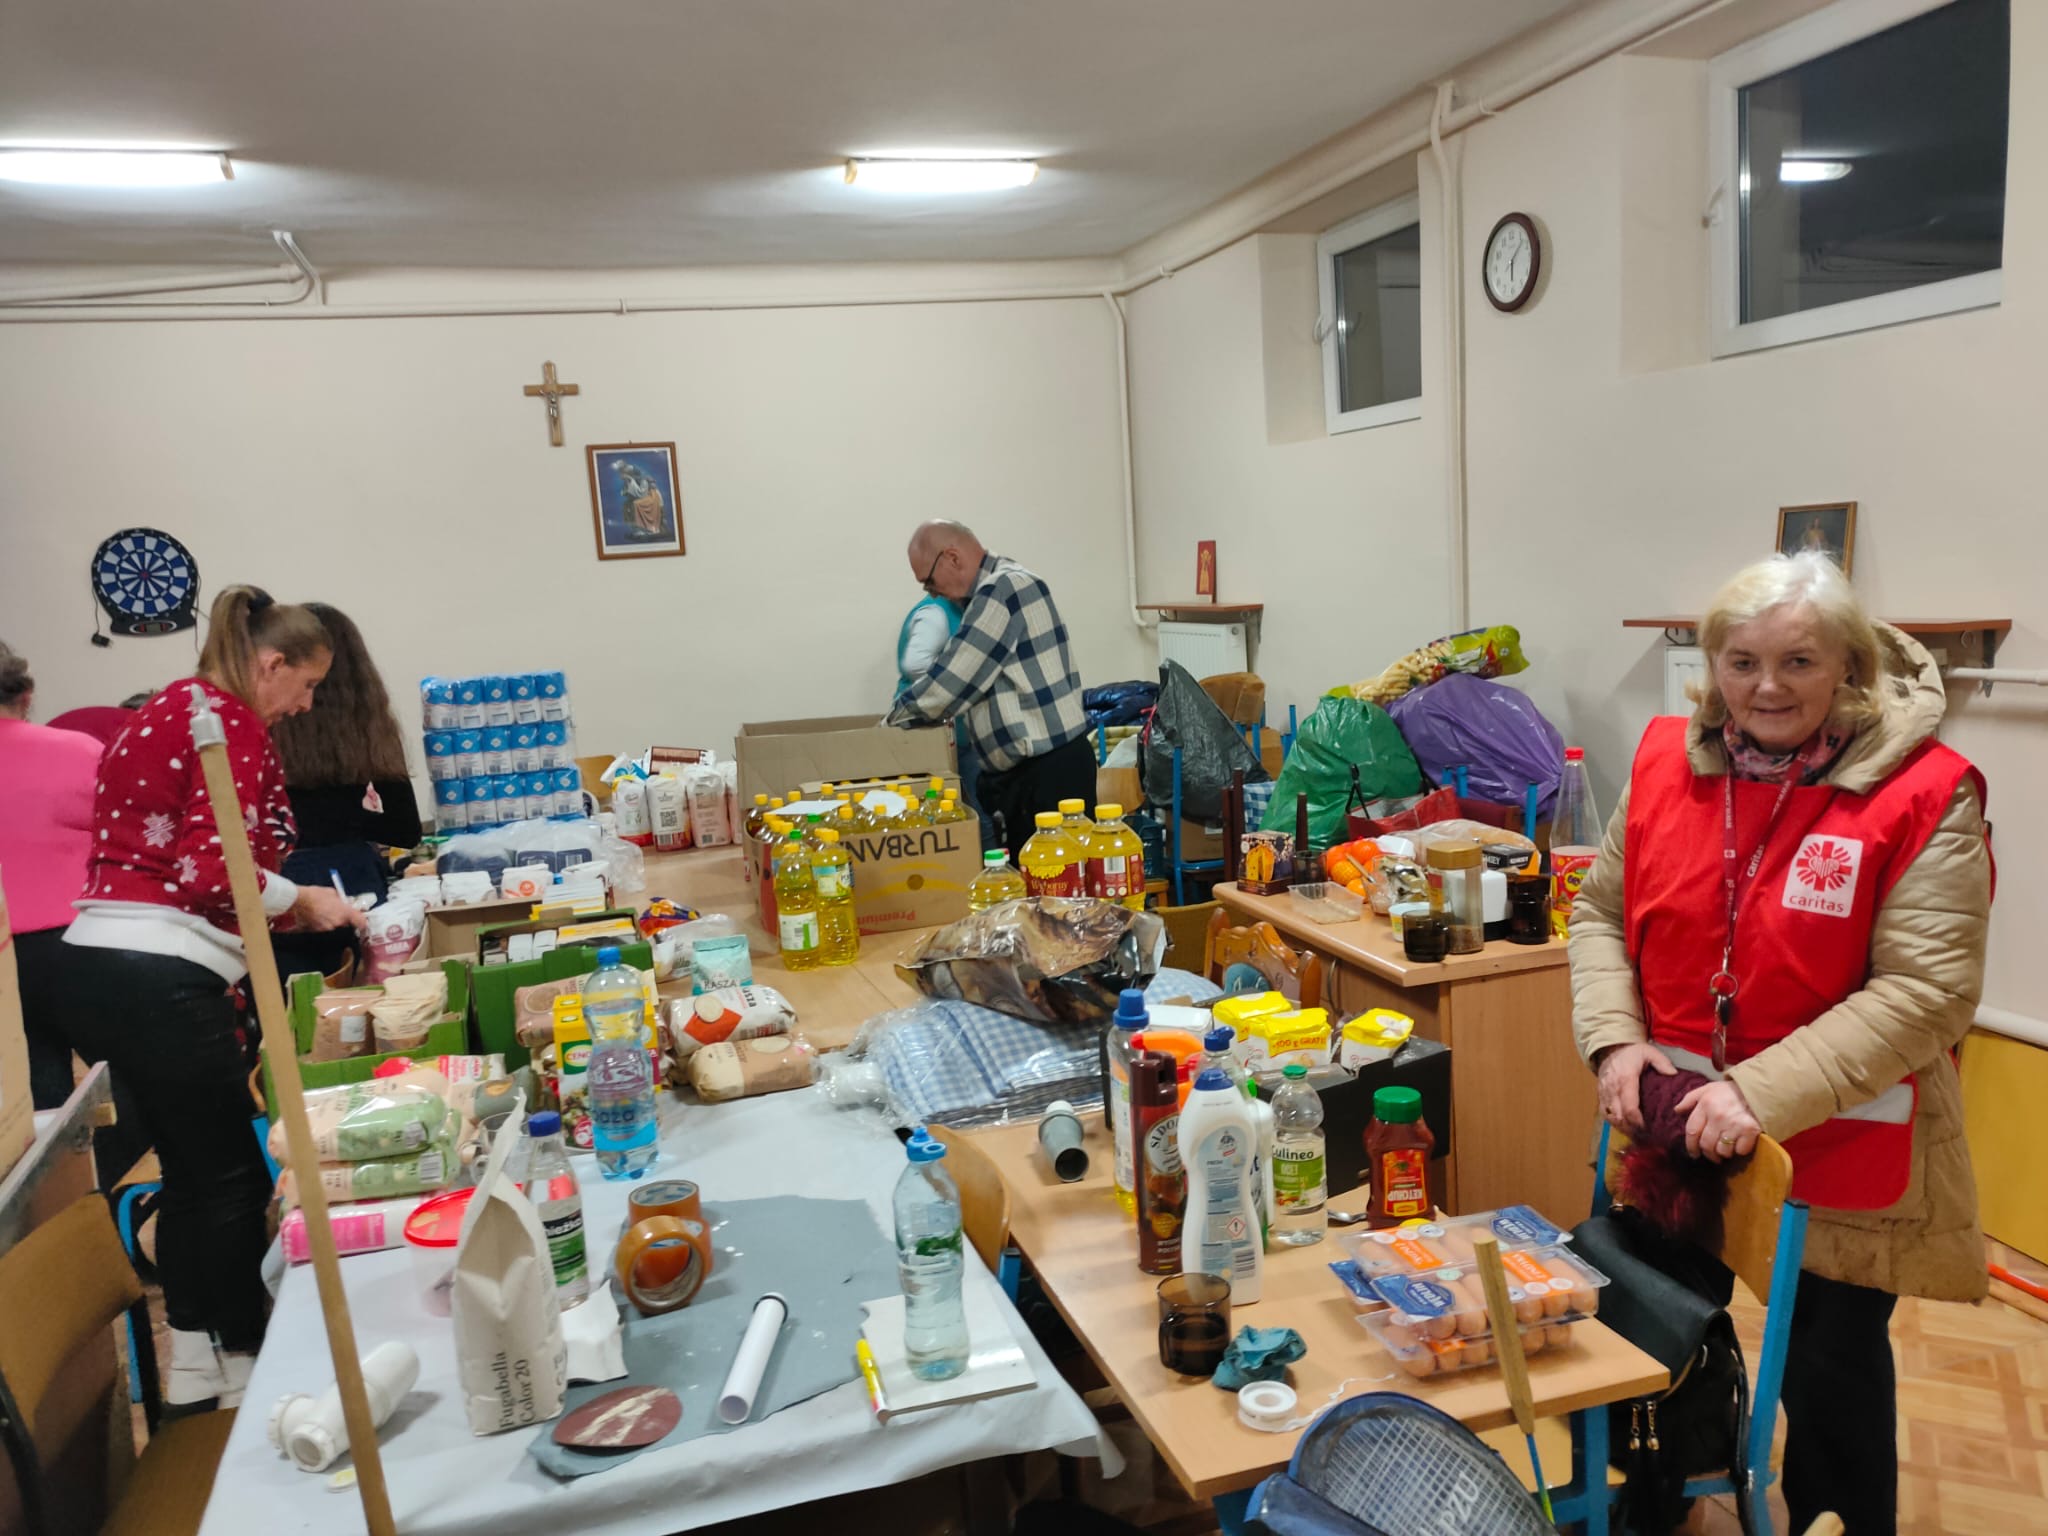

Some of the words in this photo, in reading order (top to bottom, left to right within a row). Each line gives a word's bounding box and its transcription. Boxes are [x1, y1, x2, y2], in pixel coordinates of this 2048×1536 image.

[1746, 844, 1765, 878] caritas
[1789, 894, 1844, 913] caritas
[1387, 1187, 1424, 1202] KETCHUP
[513, 1359, 531, 1380] 20
[490, 1351, 516, 1429] Fugabella
[519, 1381, 537, 1423] Color
